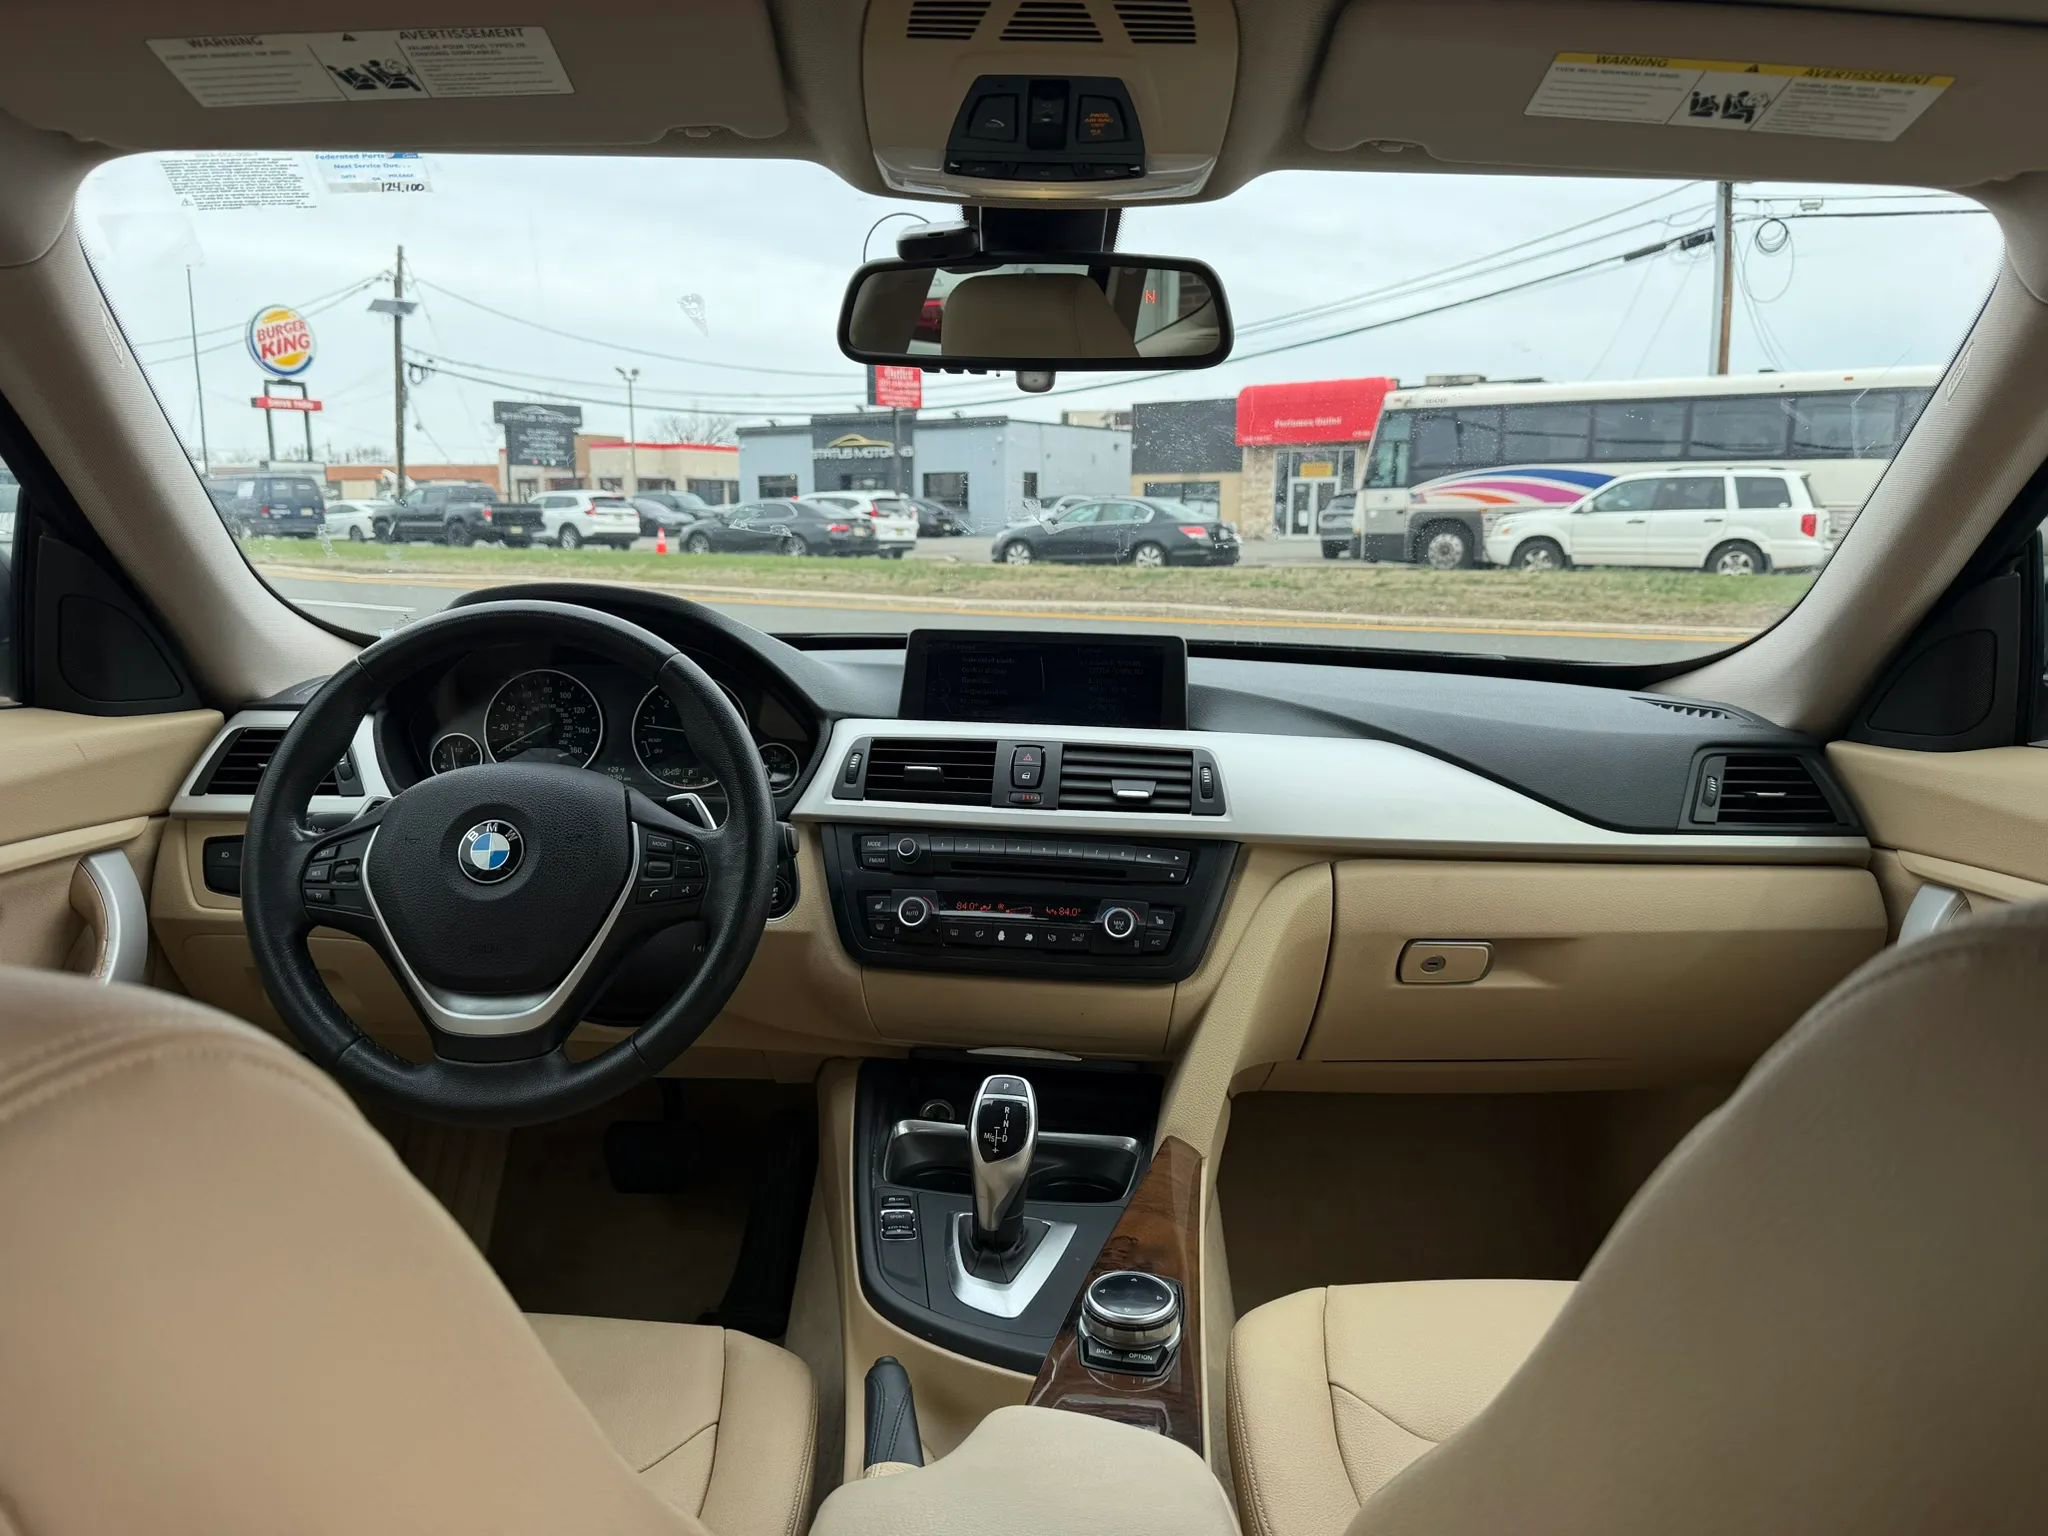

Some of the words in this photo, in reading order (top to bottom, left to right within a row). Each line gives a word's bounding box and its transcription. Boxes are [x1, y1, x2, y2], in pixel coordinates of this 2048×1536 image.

[399, 27, 525, 40] AVERTISSEMENT
[187, 35, 264, 48] WARNING
[1595, 55, 1669, 68] WARNING
[1801, 67, 1932, 85] AVERTISSEMENT
[1145, 289, 1156, 304] N
[256, 319, 306, 342] BURGER
[260, 333, 311, 360] KING
[811, 447, 853, 460] STATUS
[559, 691, 572, 699] 100
[505, 704, 516, 712] 40
[663, 699, 671, 708] 2
[573, 706, 586, 714] 120
[499, 723, 510, 731] 20
[578, 726, 590, 734] 140
[570, 746, 583, 754] 160
[467, 822, 519, 842] BMW
[320, 849, 329, 857] SET
[1004, 1106, 1010, 1114] R
[1002, 1120, 1009, 1128] N
[983, 1132, 995, 1143] M/S
[1002, 1135, 1008, 1143] D
[1128, 1352, 1154, 1361] OPTION
